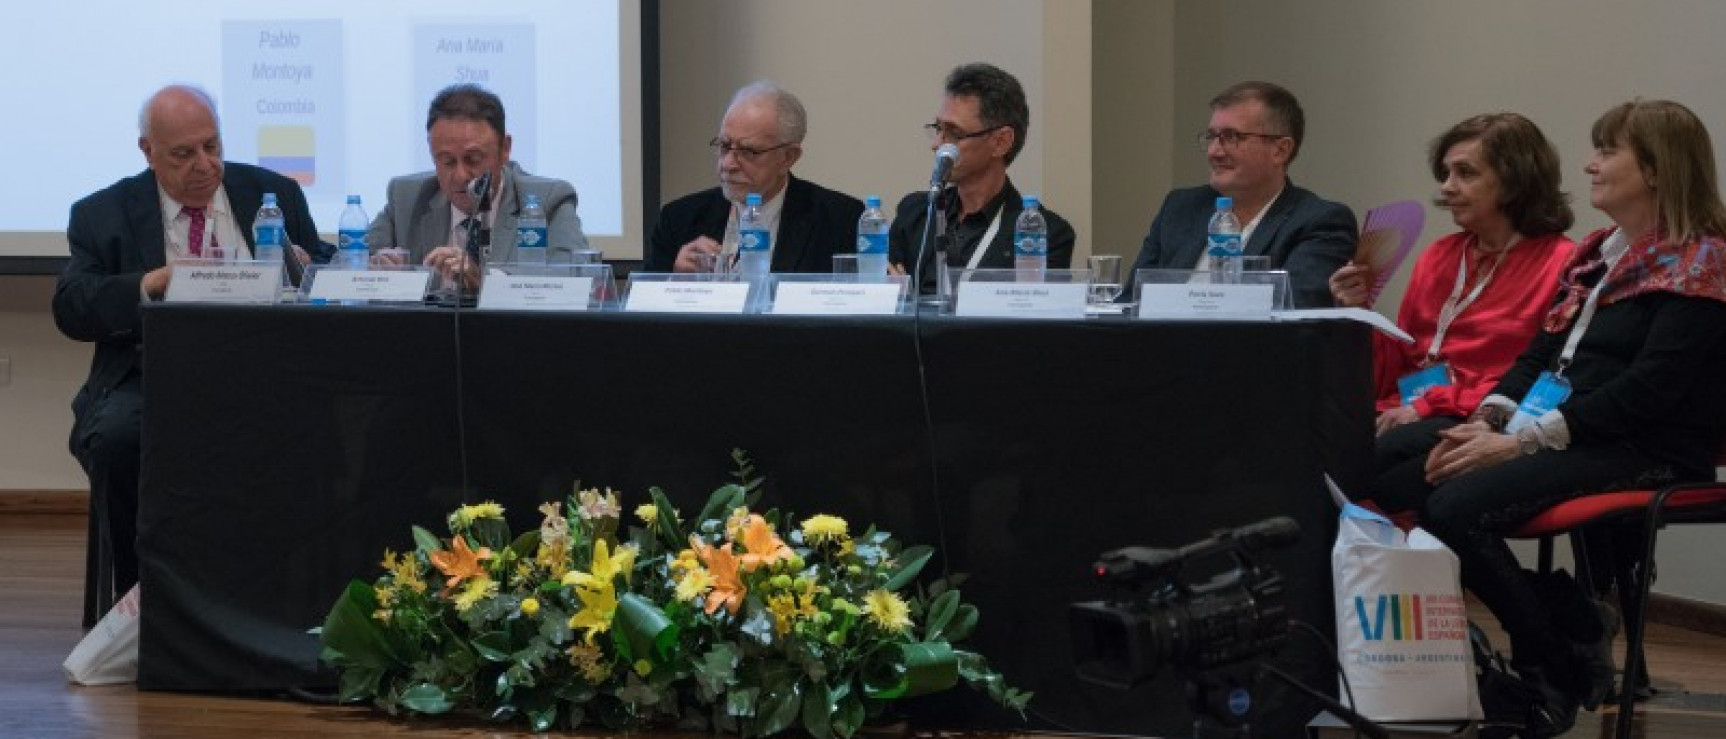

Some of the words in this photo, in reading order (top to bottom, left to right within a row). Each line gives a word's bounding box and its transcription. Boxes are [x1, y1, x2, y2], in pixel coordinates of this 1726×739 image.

[258, 30, 301, 48] Pablo
[435, 37, 464, 54] Ana
[251, 62, 313, 84] Montoya
[454, 65, 490, 82] Shua
[256, 99, 316, 115] Colombia
[1354, 593, 1423, 641] VIII
